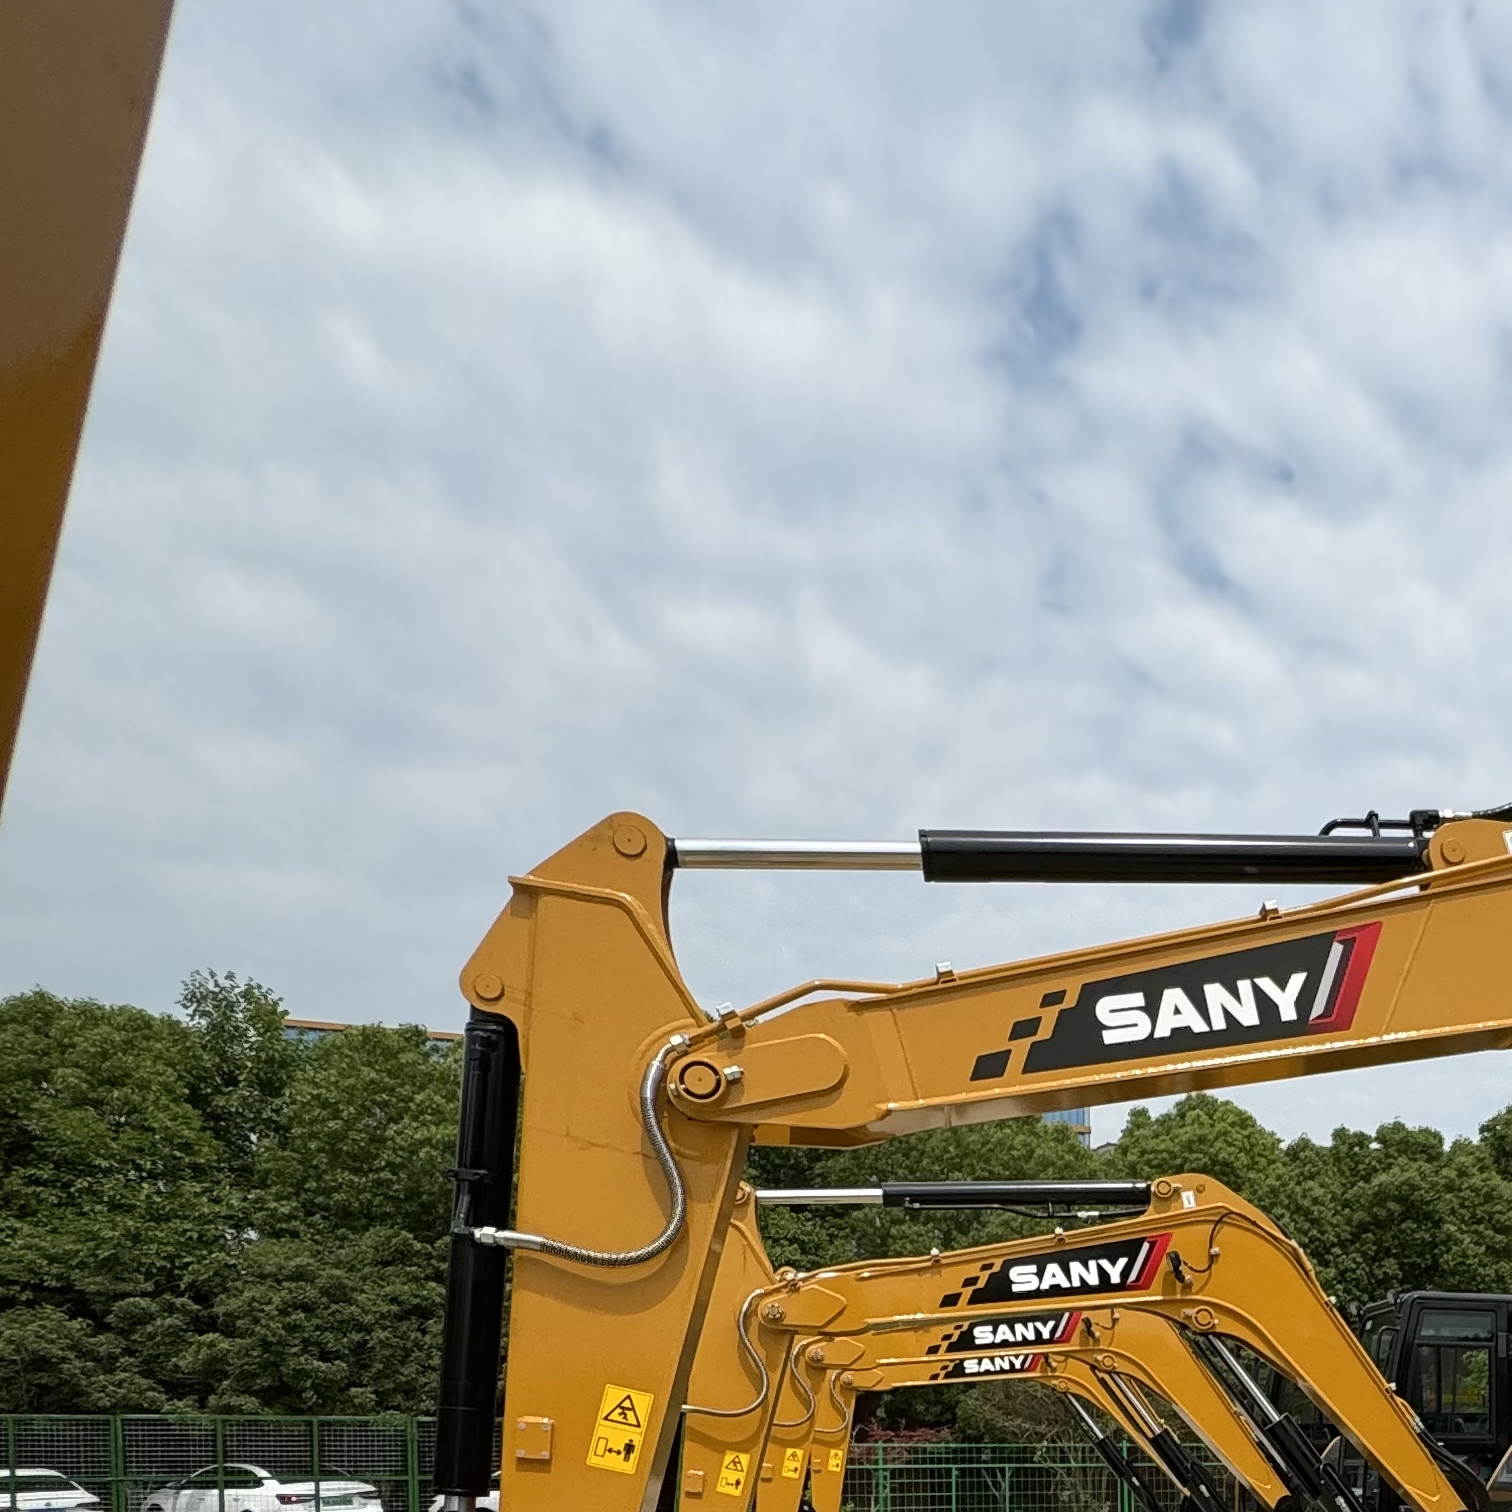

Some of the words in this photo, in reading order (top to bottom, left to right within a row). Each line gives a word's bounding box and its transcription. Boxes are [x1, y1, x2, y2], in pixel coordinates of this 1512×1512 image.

[1095, 971, 1308, 1045] SANY
[1008, 1257, 1129, 1293] SANY
[972, 1320, 1056, 1345] SANY
[963, 1354, 1025, 1374] SANY
